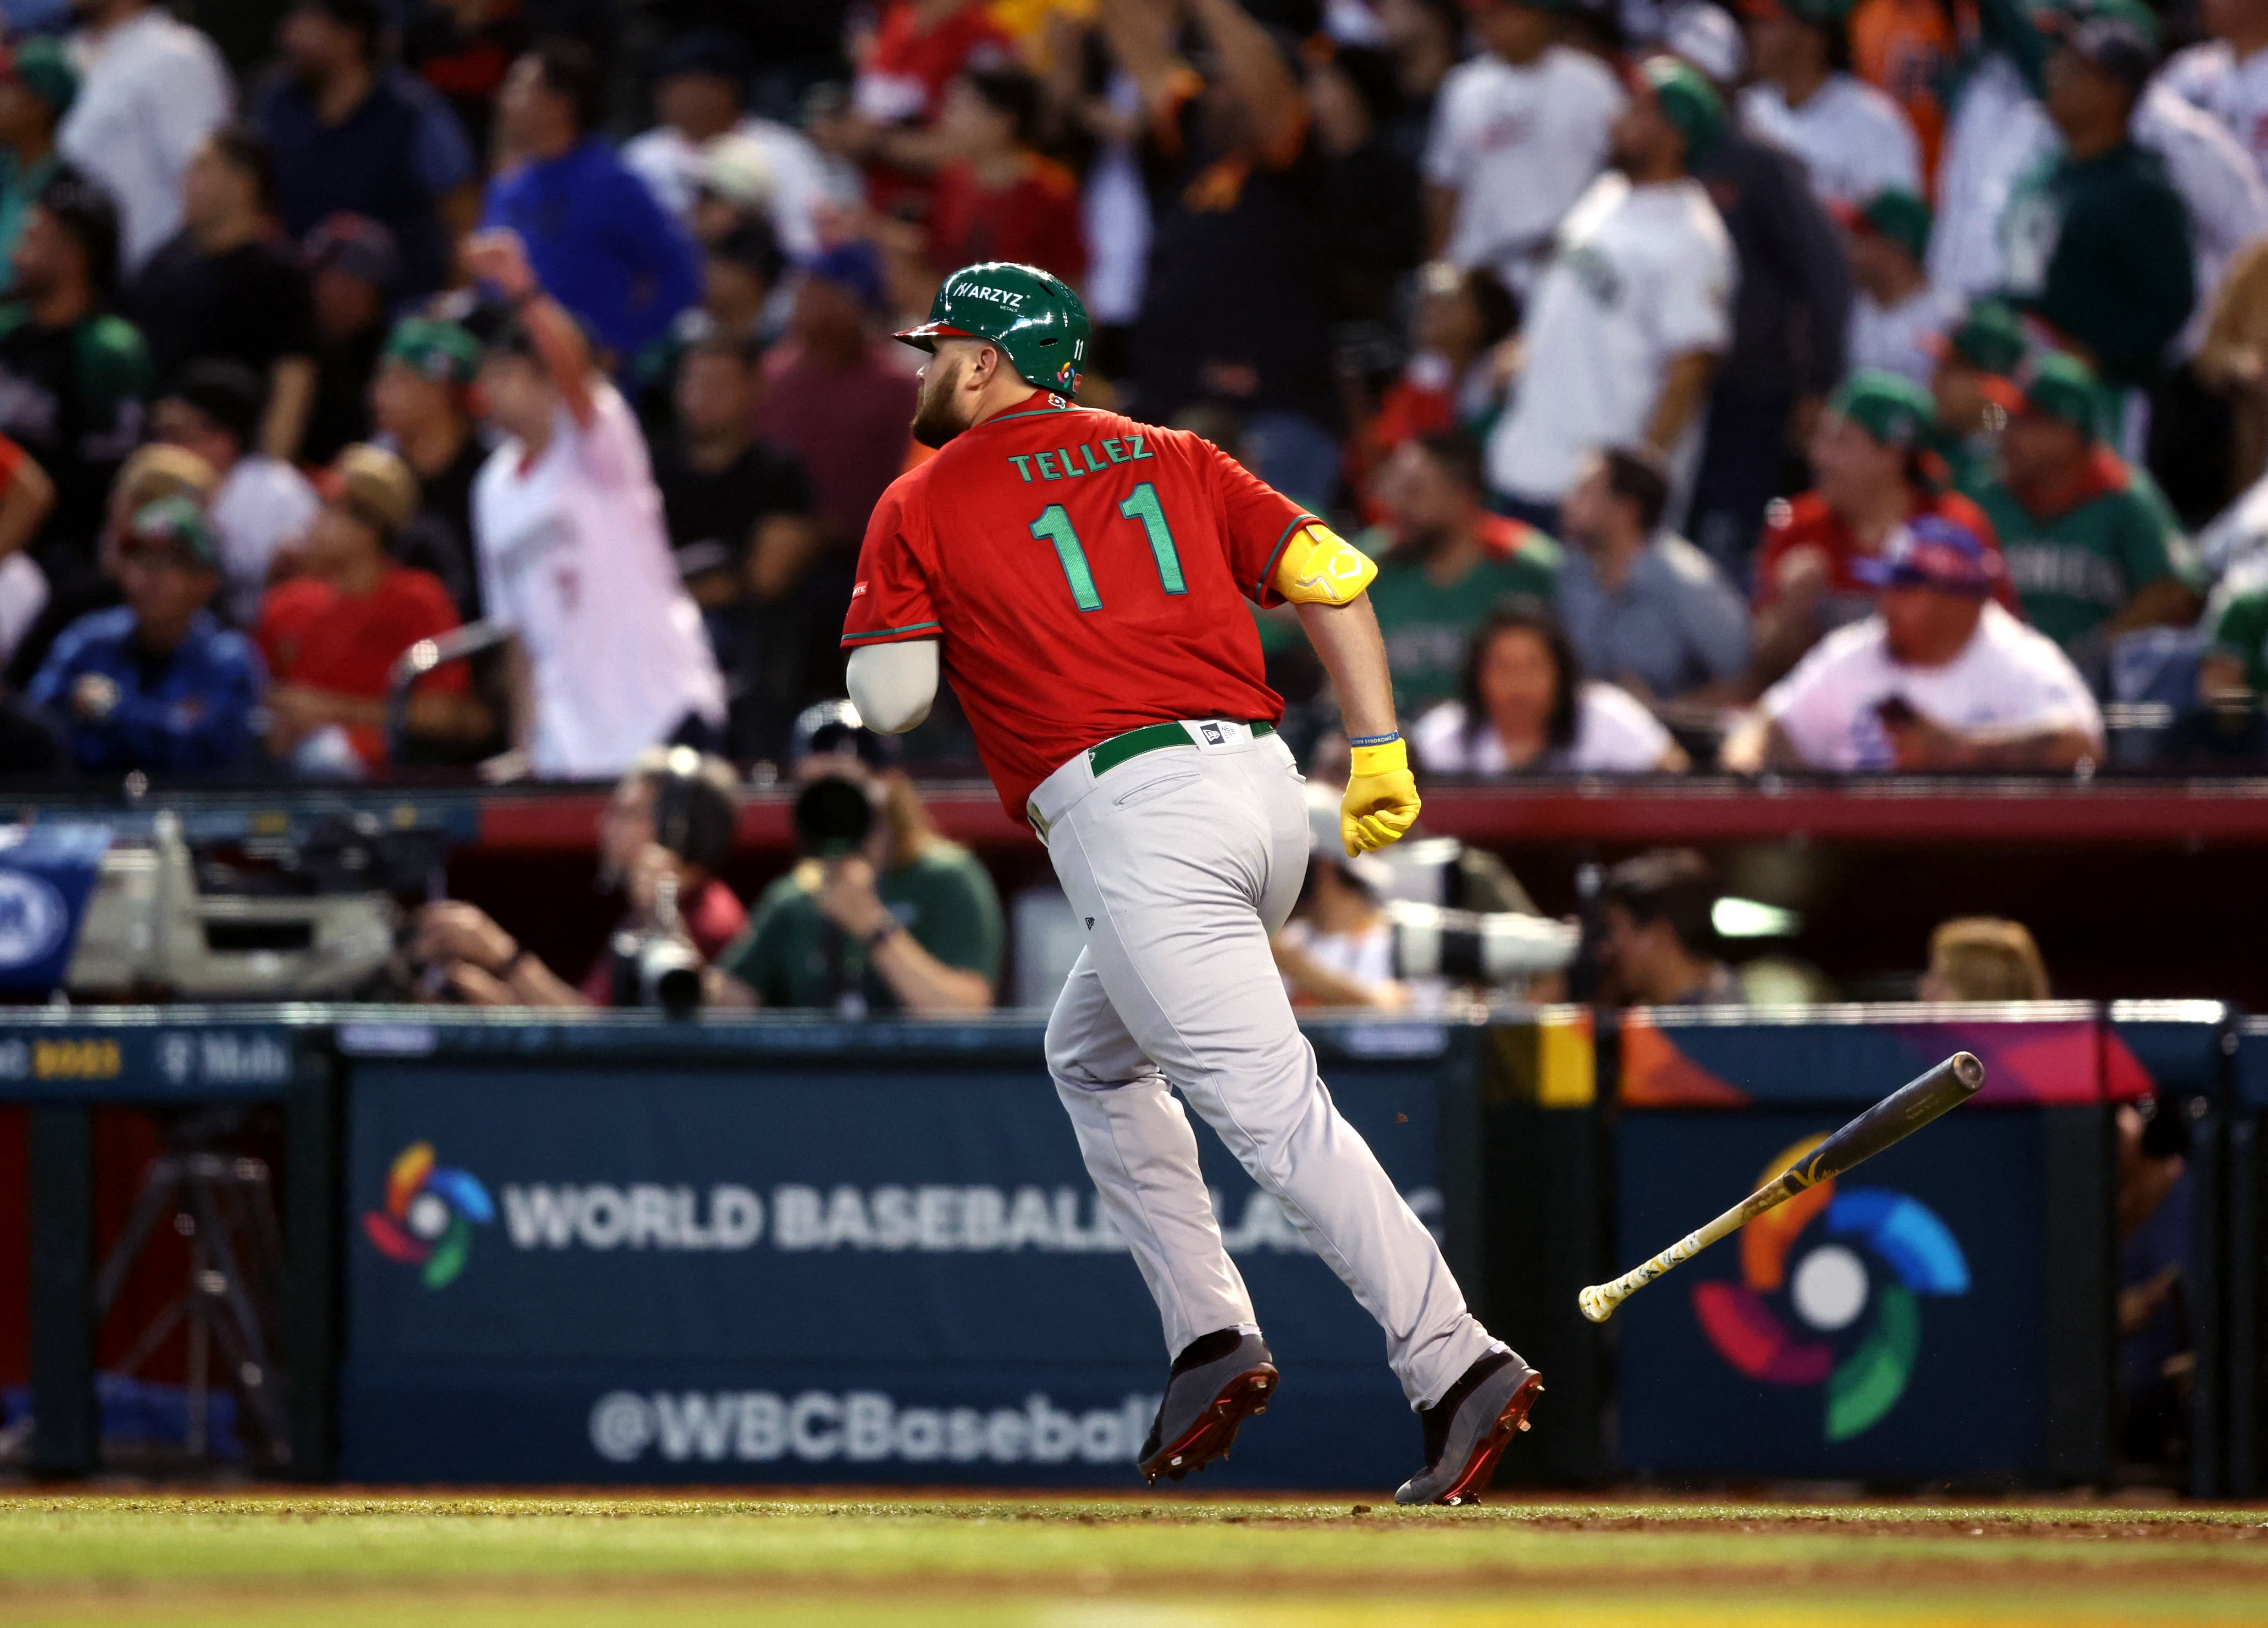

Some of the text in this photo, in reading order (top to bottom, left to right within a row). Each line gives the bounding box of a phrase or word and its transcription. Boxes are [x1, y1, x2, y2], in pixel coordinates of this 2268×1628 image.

[1074, 338, 1084, 361] 11
[1008, 435, 1154, 483] TELLEZ
[1028, 482, 1188, 612] 11
[1364, 736, 1392, 744] SYNDROME
[502, 1184, 763, 1250] WORLD
[773, 1184, 1130, 1252] BASEBALL
